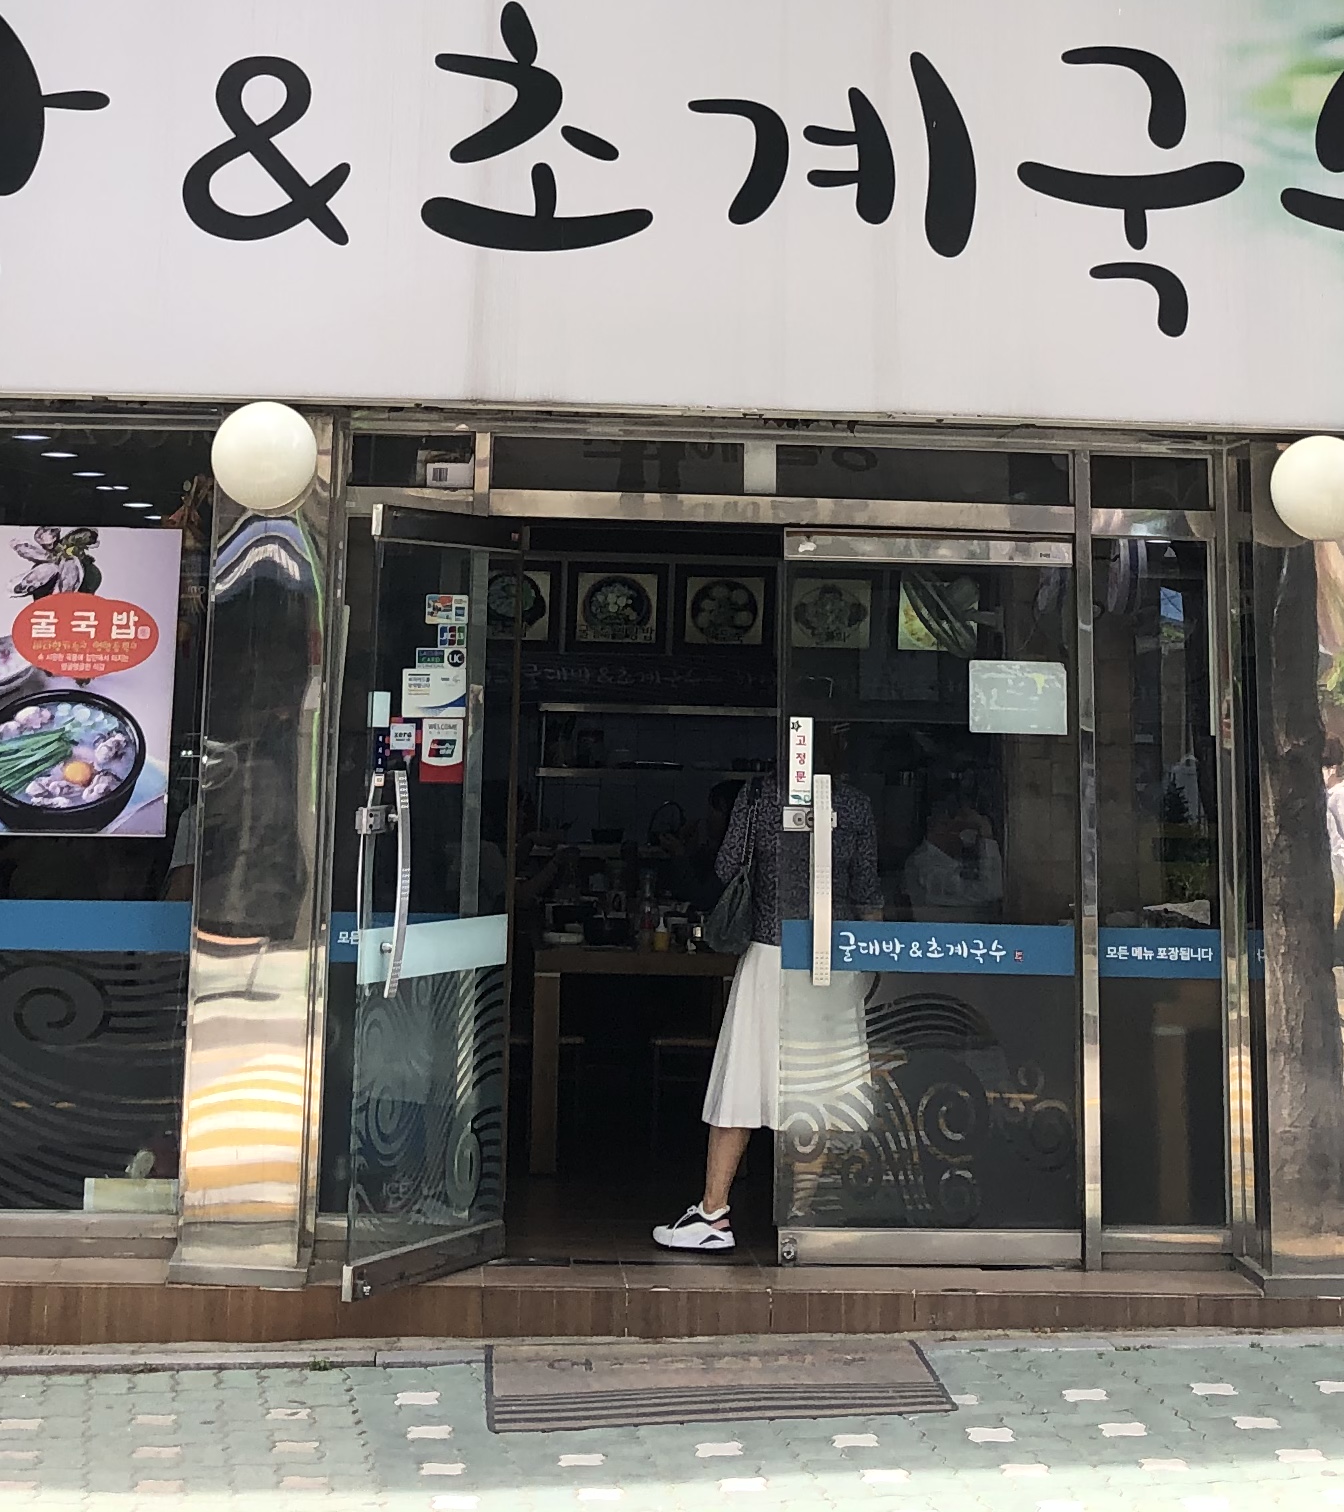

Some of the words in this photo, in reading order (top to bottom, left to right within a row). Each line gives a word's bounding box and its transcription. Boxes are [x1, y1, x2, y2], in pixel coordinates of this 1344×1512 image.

[182, 54, 351, 247] &
[30, 610, 139, 639] 굴국밥
[448, 654, 464, 664] UC
[795, 735, 807, 783] 고정문
[839, 931, 905, 962] 굴대박
[909, 941, 923, 958] &
[926, 937, 1006, 963] 초계국수
[1106, 946, 1129, 960] 모든
[1131, 946, 1154, 961] 메뉴
[1156, 947, 1213, 962] 포장됩니다
